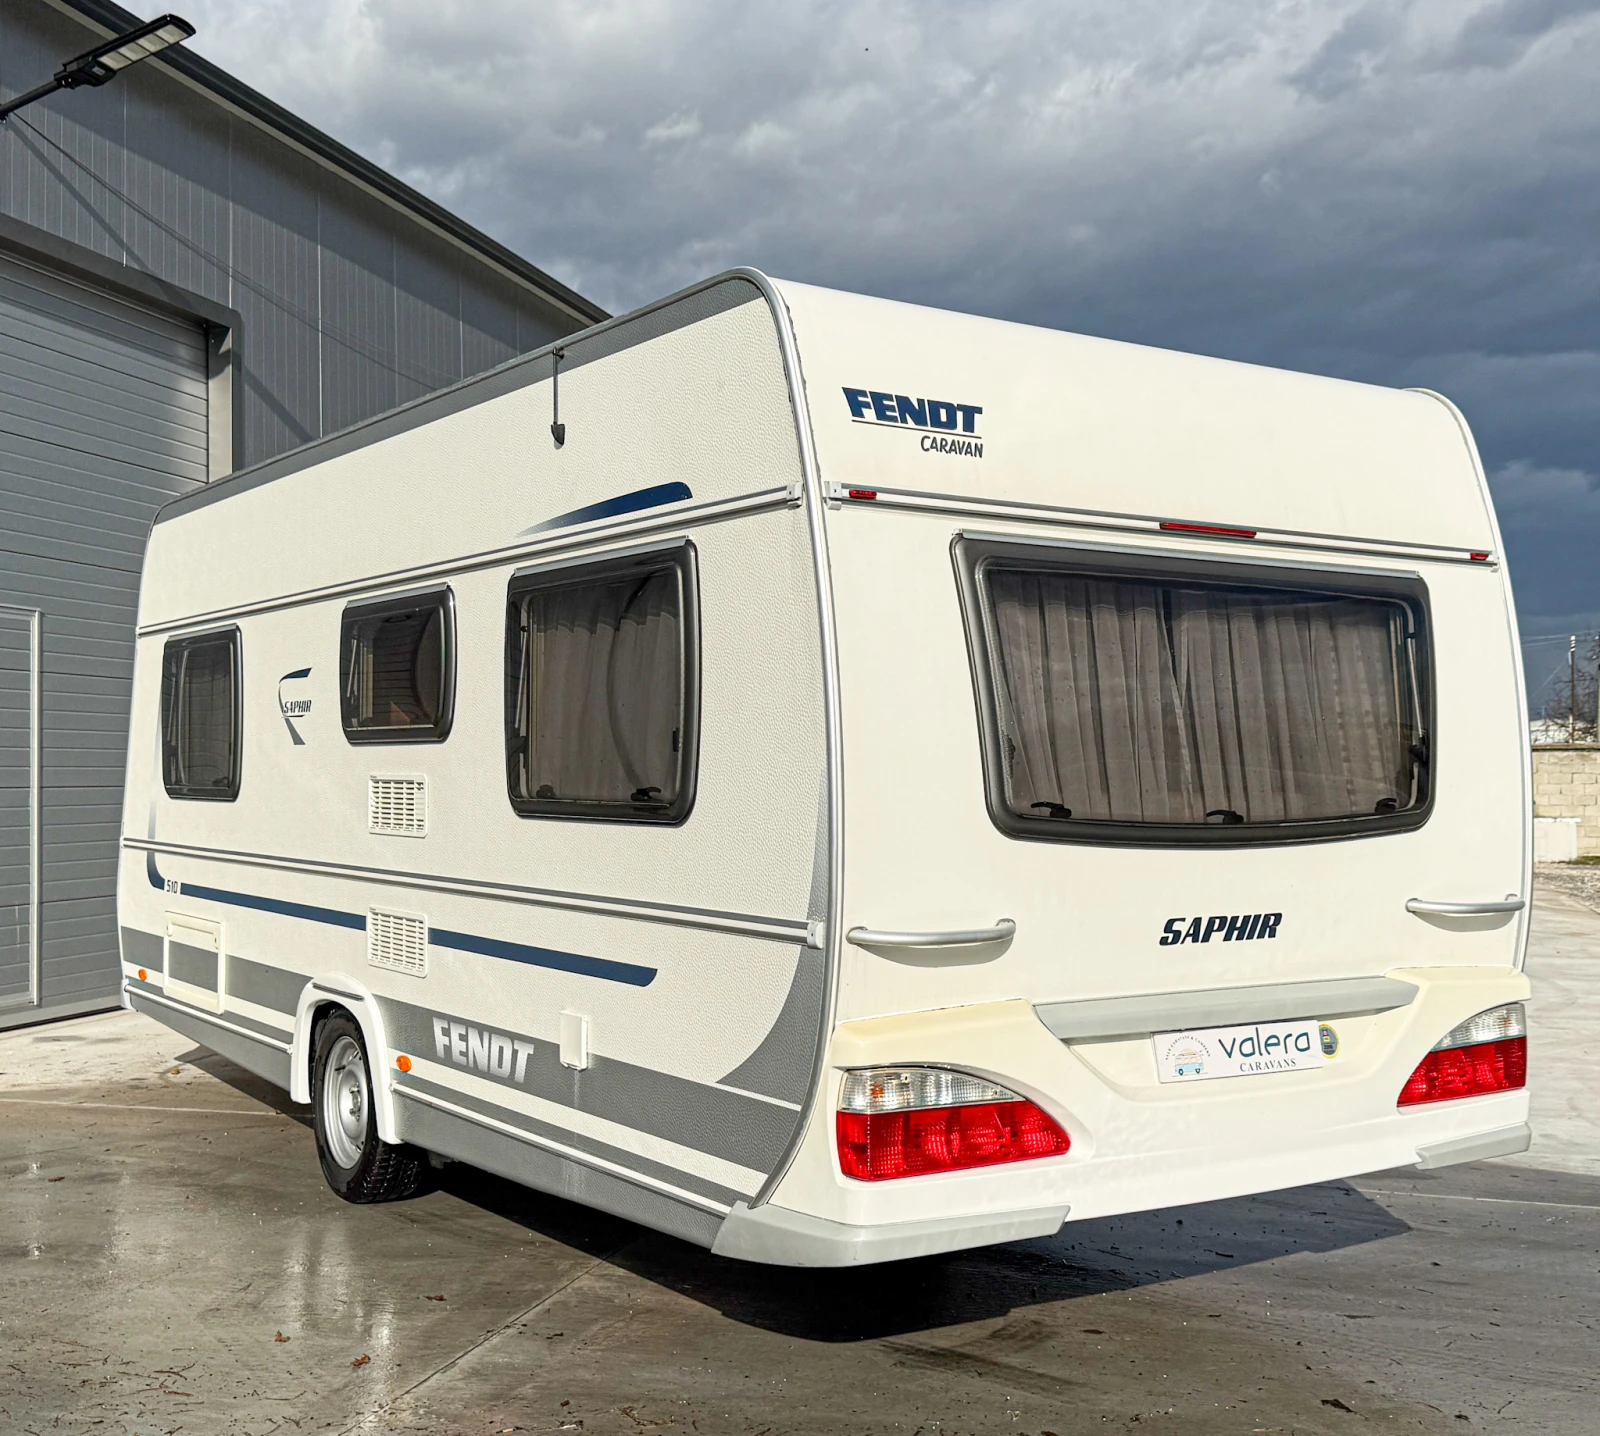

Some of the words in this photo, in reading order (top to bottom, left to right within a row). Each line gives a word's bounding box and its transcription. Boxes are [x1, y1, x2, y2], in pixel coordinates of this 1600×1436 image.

[841, 386, 983, 434] FENDT
[920, 435, 984, 459] CARAVAN
[283, 699, 312, 714] SAPHIR
[166, 879, 179, 894] 510
[1158, 912, 1283, 946] SAPHIR
[432, 1016, 535, 1084] FENDT
[1218, 1026, 1311, 1059] valera
[1239, 1057, 1297, 1073] CARAVANS
